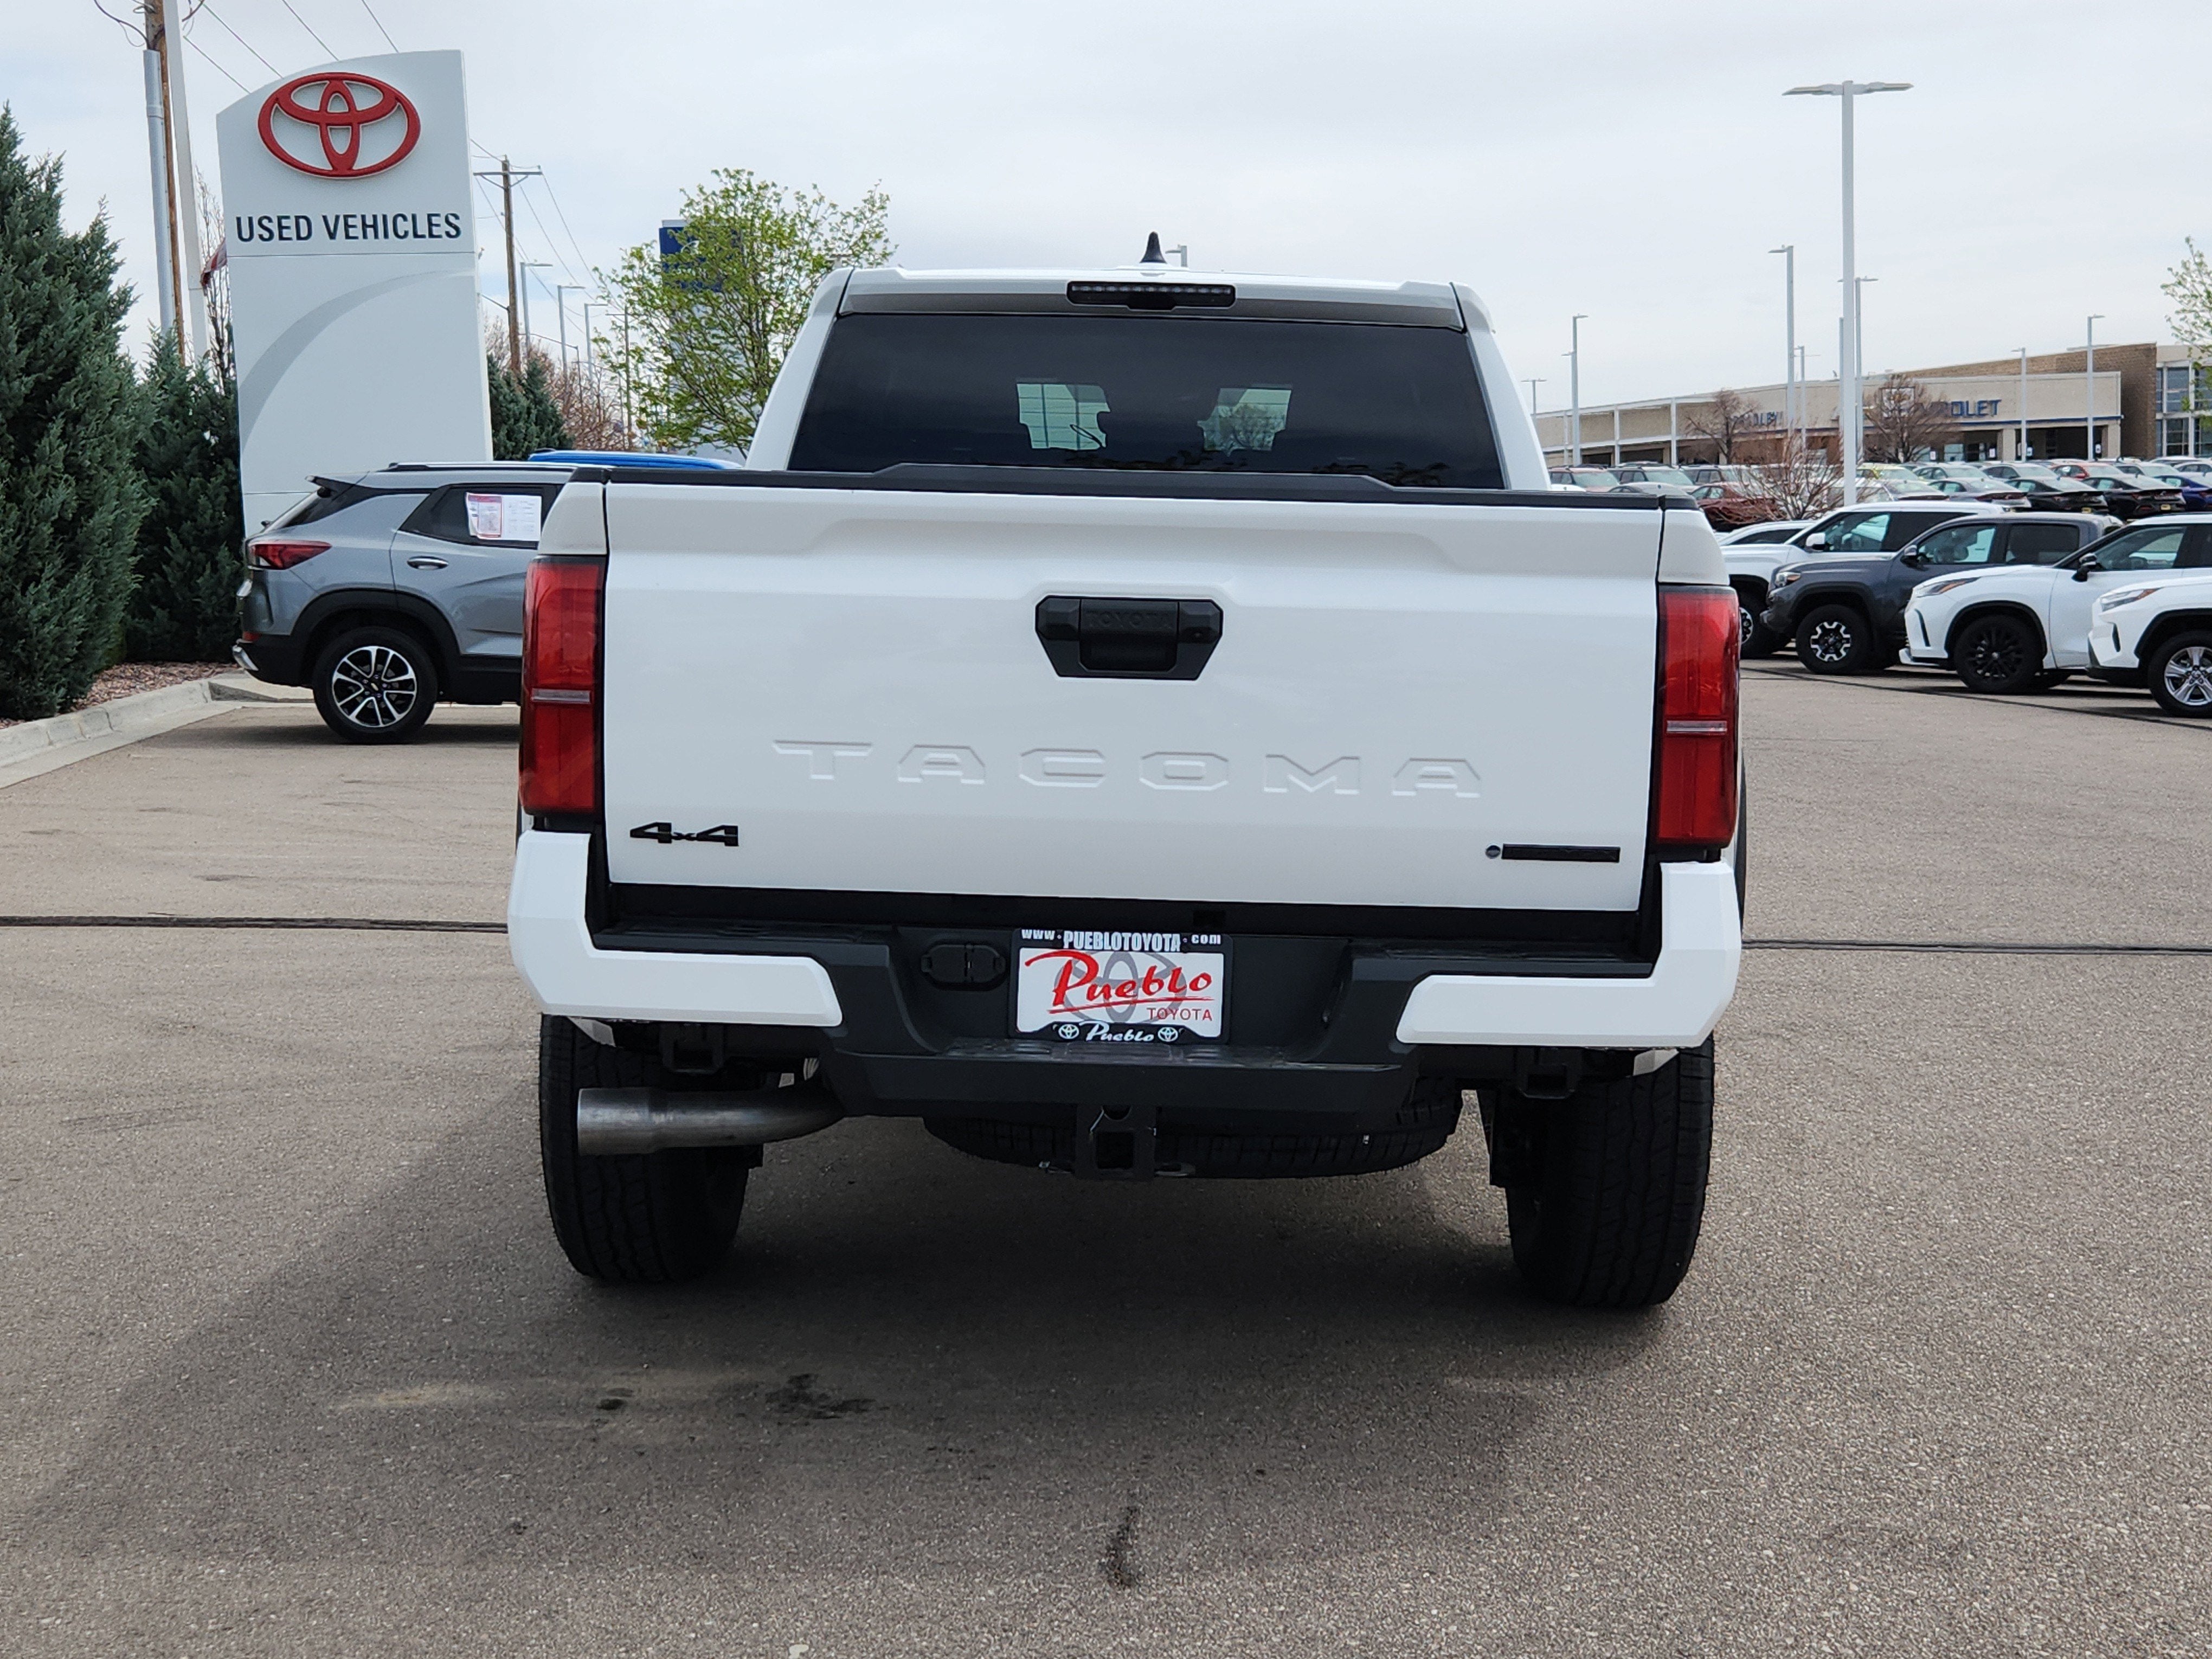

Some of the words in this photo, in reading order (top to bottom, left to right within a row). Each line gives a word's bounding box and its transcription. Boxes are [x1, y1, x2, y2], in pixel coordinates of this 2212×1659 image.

[236, 215, 313, 242] USED
[321, 213, 462, 240] VEHICLES
[773, 740, 1481, 799] TACOMA
[629, 821, 739, 847] 4x4
[1024, 949, 1213, 1007] Pueblo
[1146, 1007, 1213, 1021] TOYOTA
[1078, 1020, 1155, 1043] Pueblo
